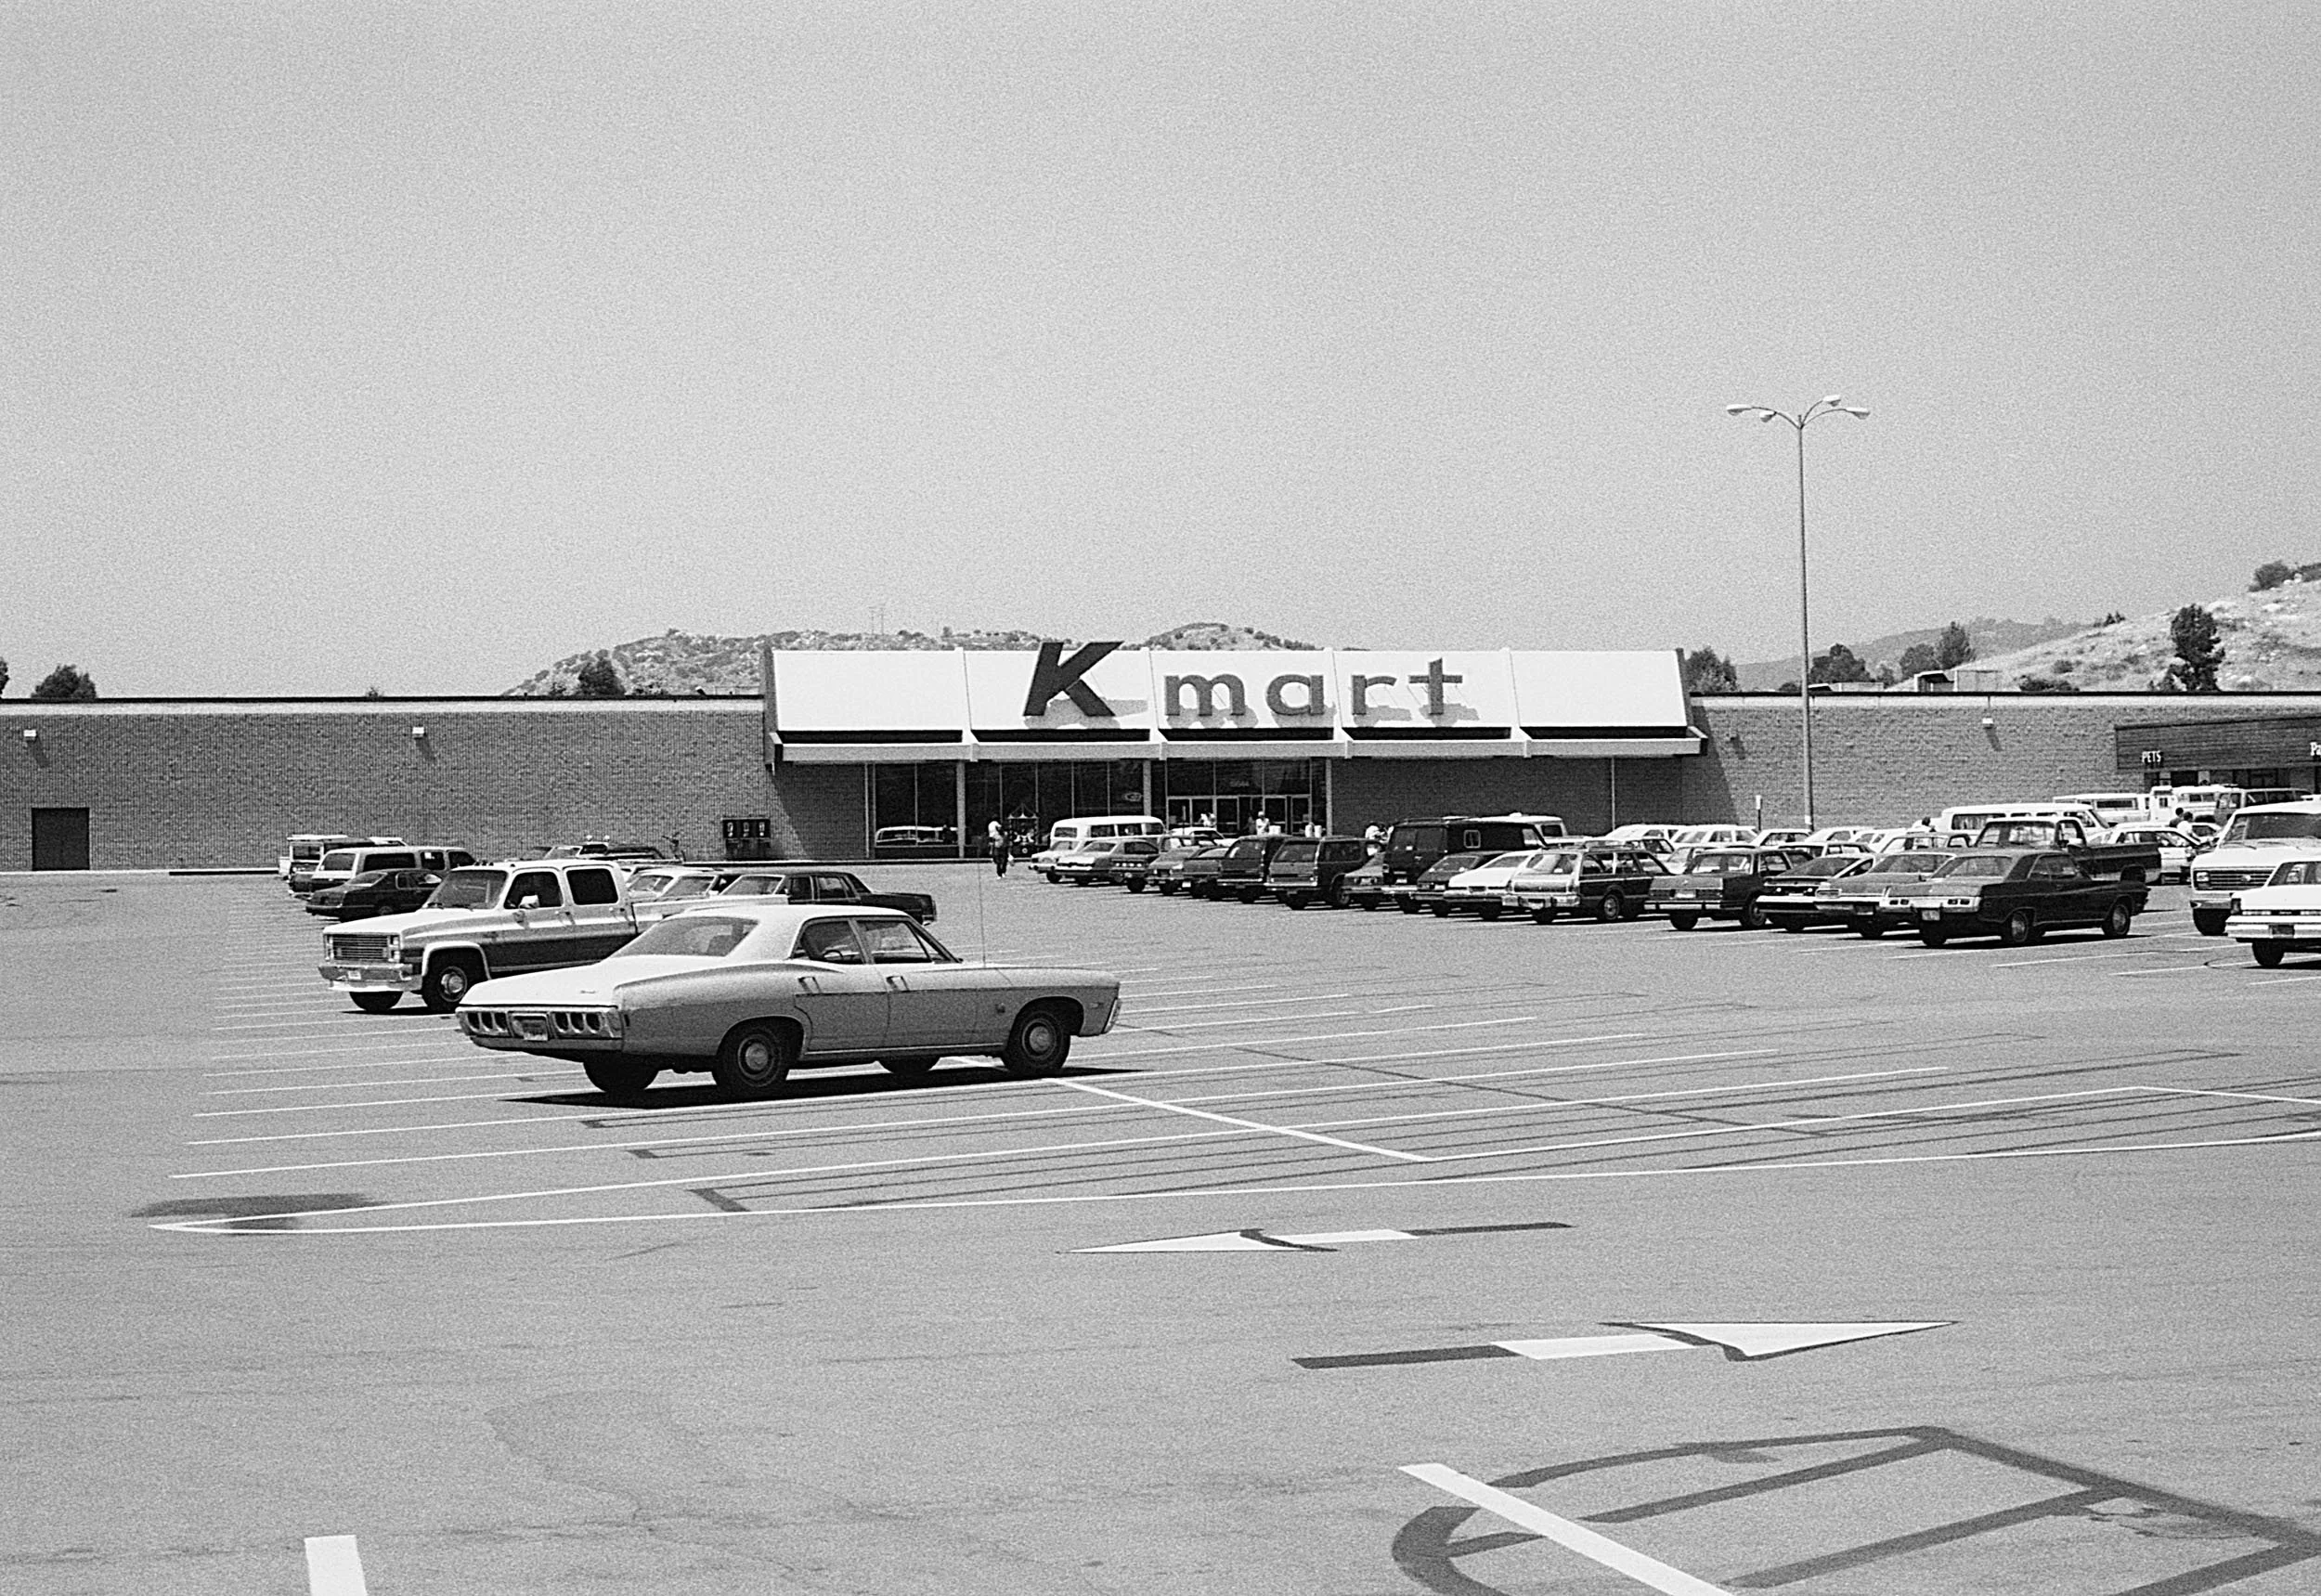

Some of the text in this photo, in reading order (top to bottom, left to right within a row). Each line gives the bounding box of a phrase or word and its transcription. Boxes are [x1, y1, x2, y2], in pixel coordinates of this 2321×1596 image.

[1023, 642, 1464, 716] K mart
[2141, 750, 2162, 763] PETS
